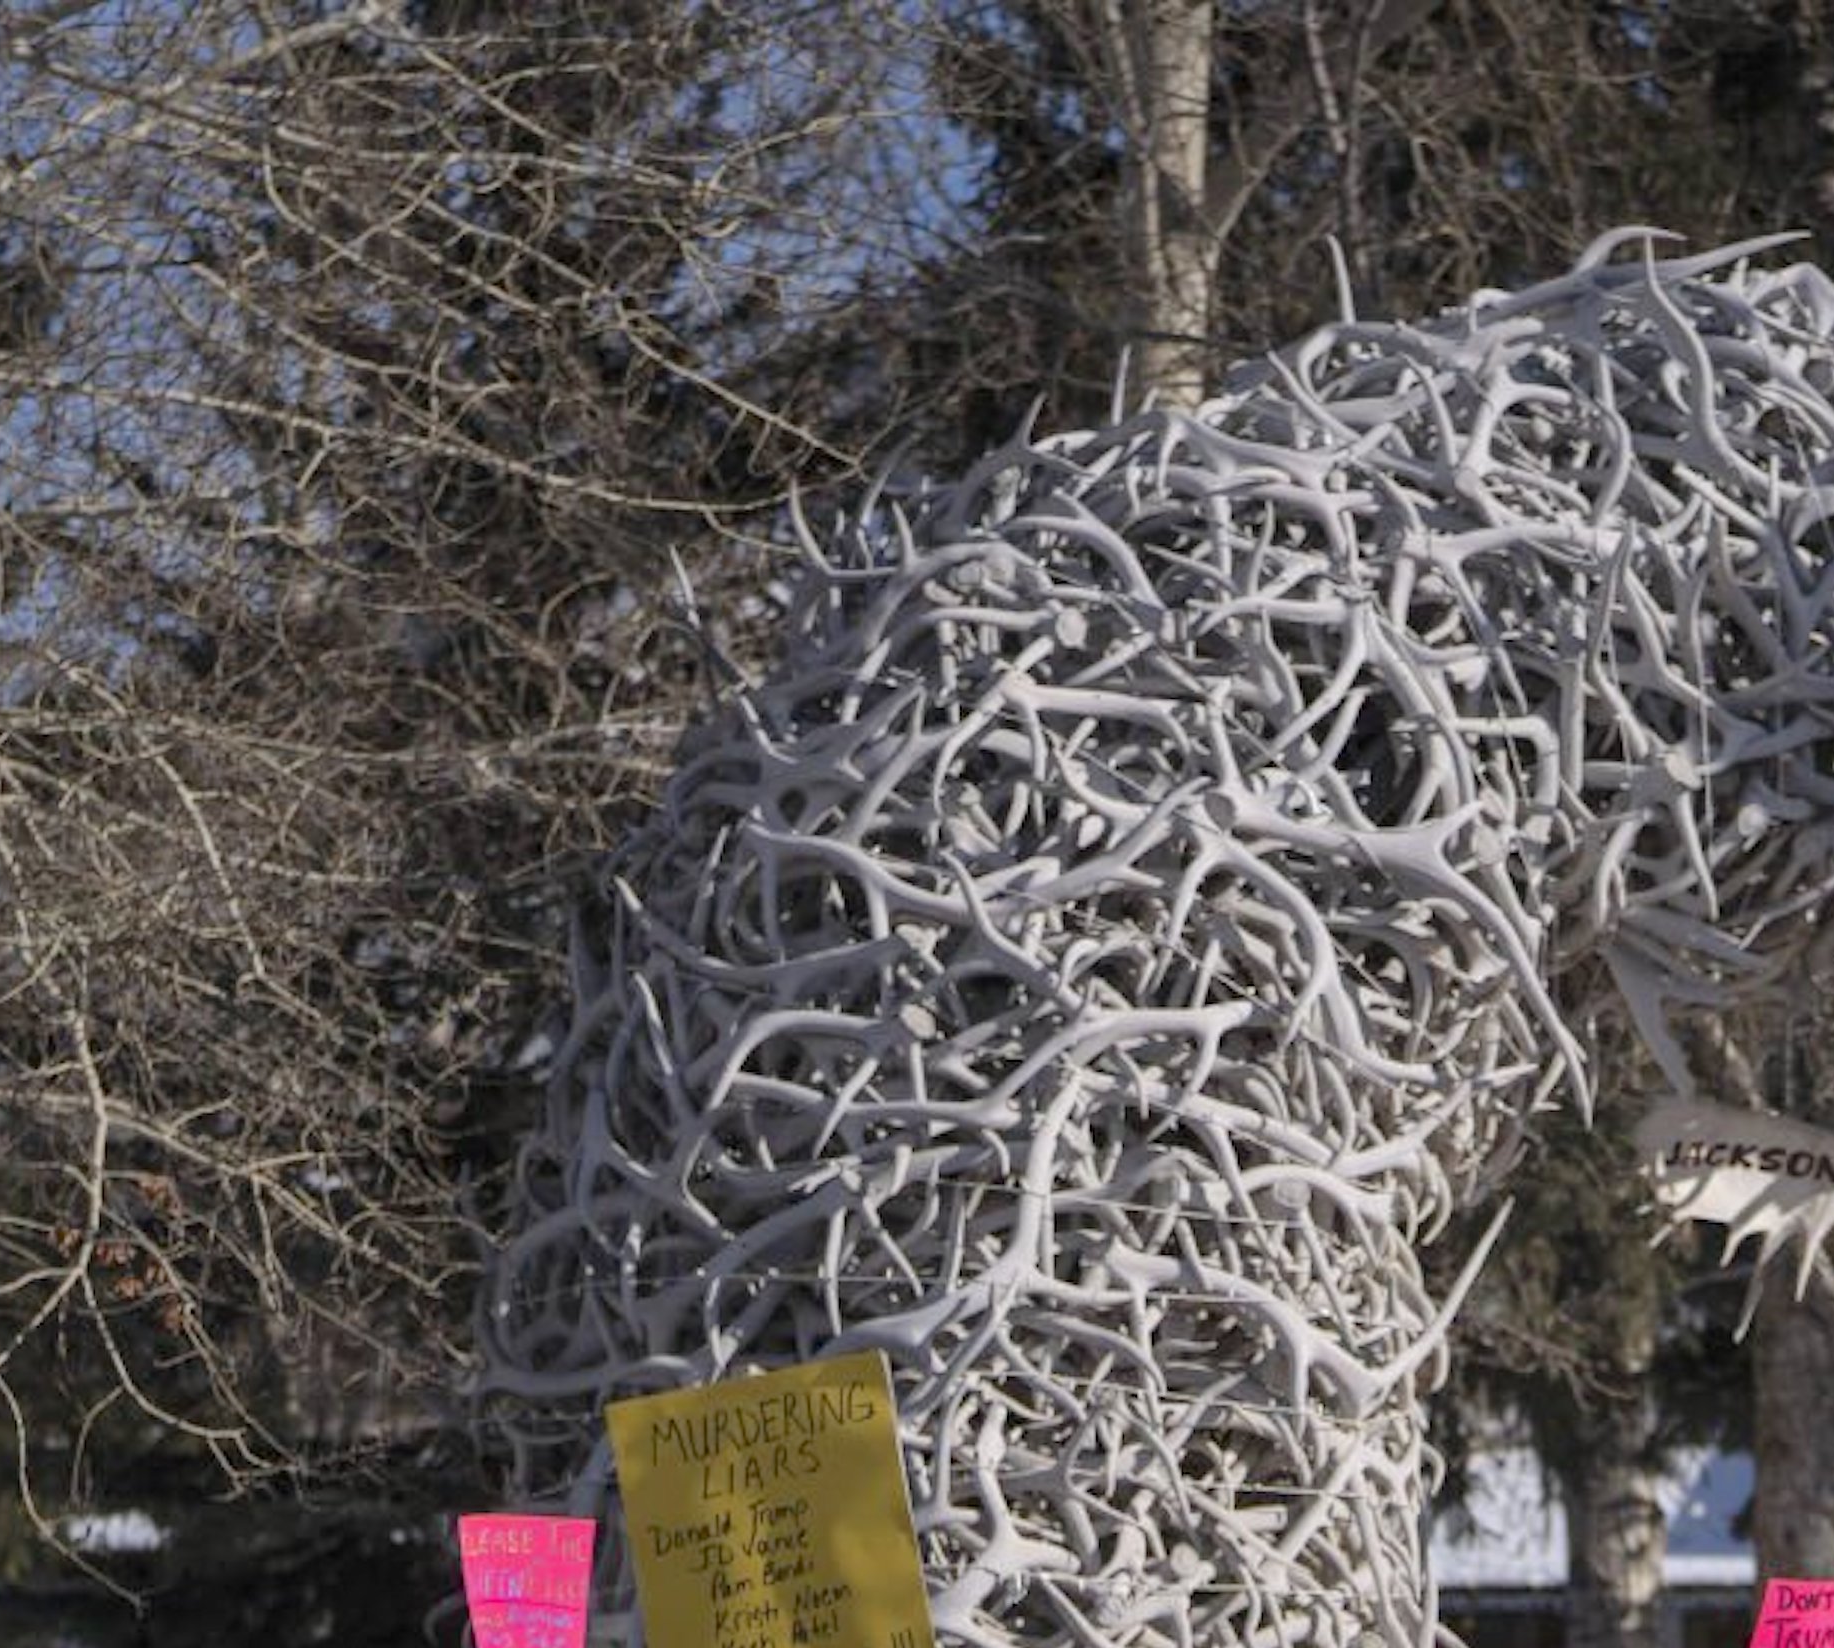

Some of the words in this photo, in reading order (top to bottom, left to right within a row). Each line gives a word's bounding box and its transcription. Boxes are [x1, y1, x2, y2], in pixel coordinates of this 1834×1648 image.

[652, 1381, 875, 1467] MURDERING
[702, 1440, 822, 1499] LIARS
[648, 1511, 732, 1558] Donald
